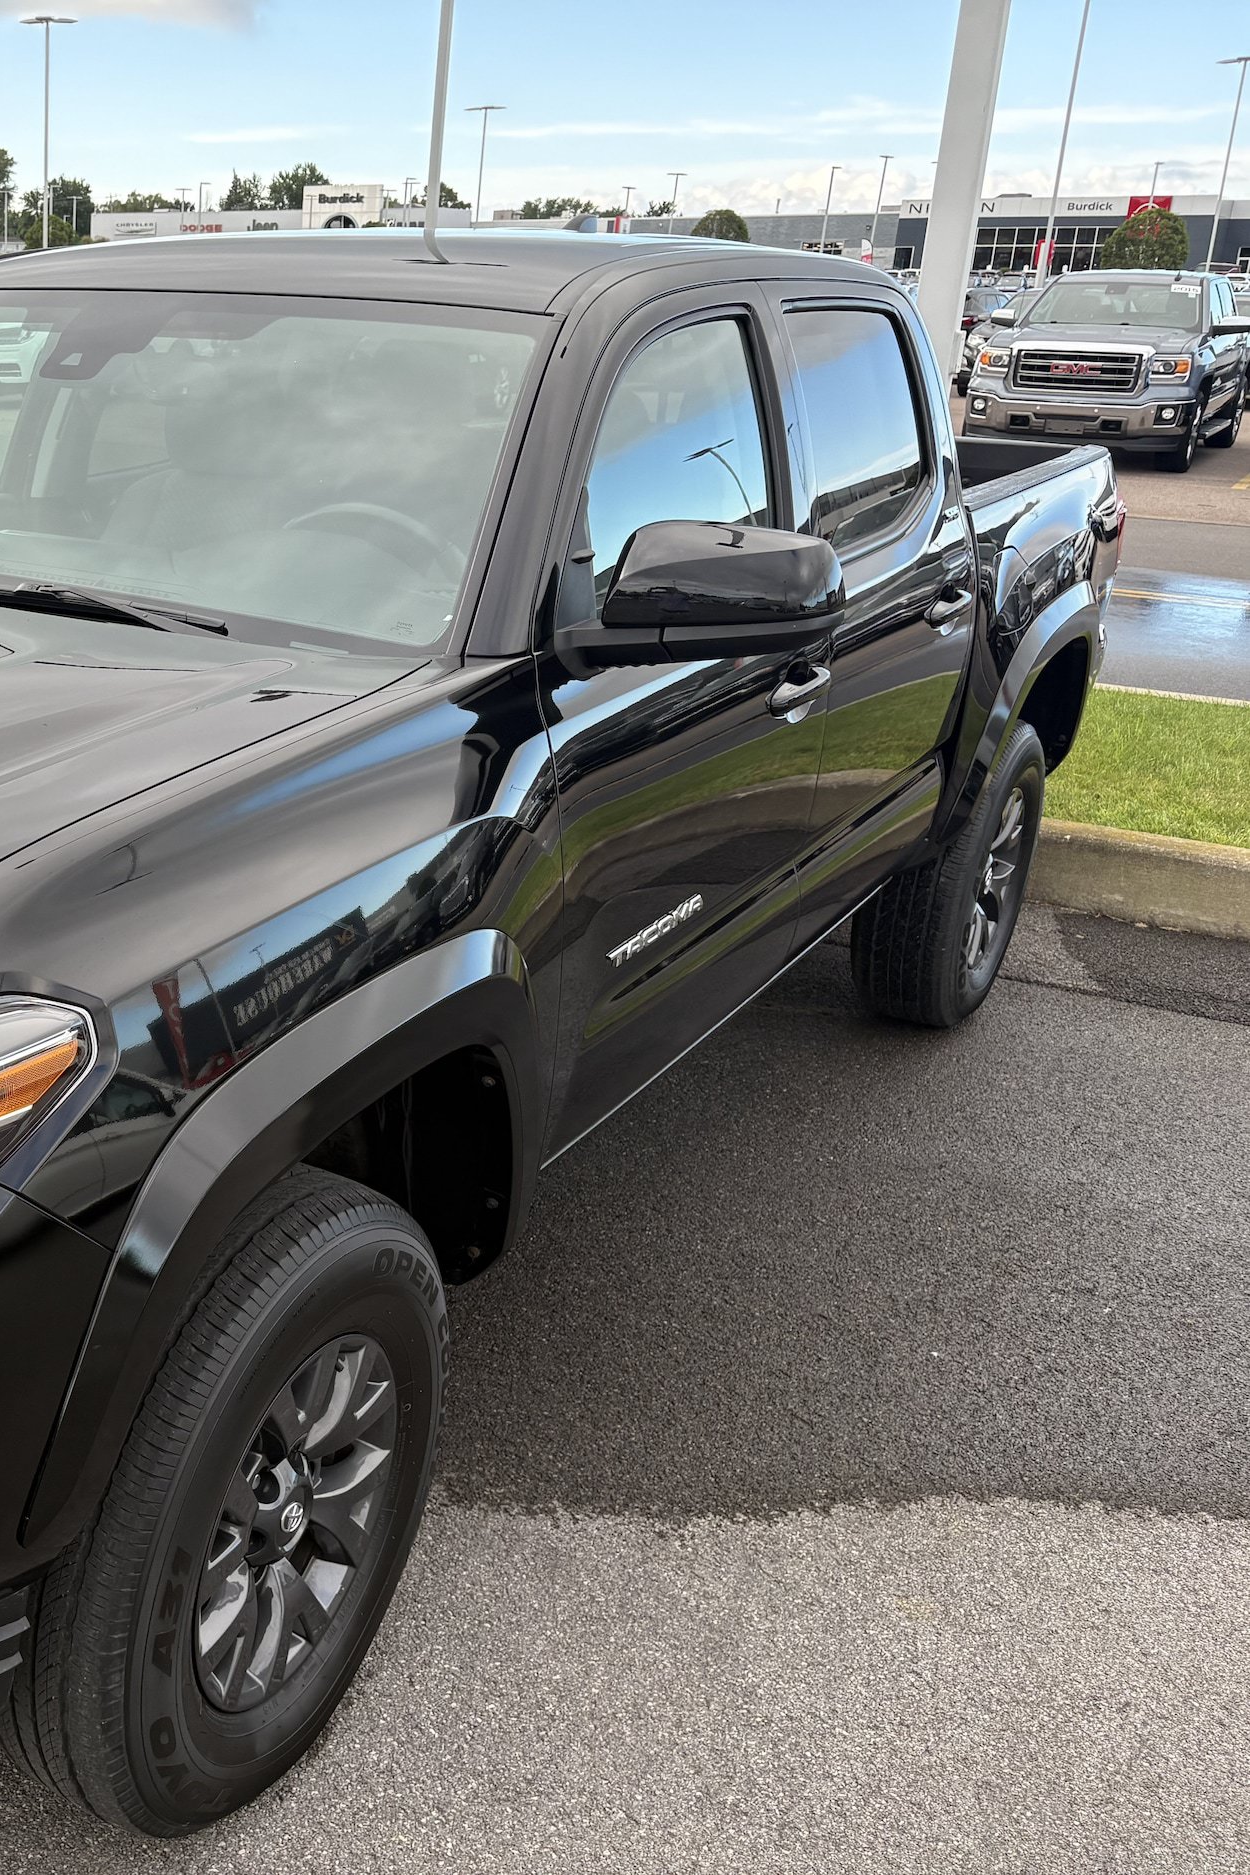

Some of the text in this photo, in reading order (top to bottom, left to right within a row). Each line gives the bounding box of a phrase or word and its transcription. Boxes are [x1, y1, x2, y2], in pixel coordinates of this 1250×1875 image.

[317, 192, 365, 204] Burdick
[1066, 201, 1113, 212] Burdick
[179, 224, 223, 233] DODGE
[1050, 361, 1101, 375] GMC
[606, 893, 704, 968] TACOMA
[372, 1247, 439, 1308] OPEN
[150, 1545, 234, 1812] TOYO A31
